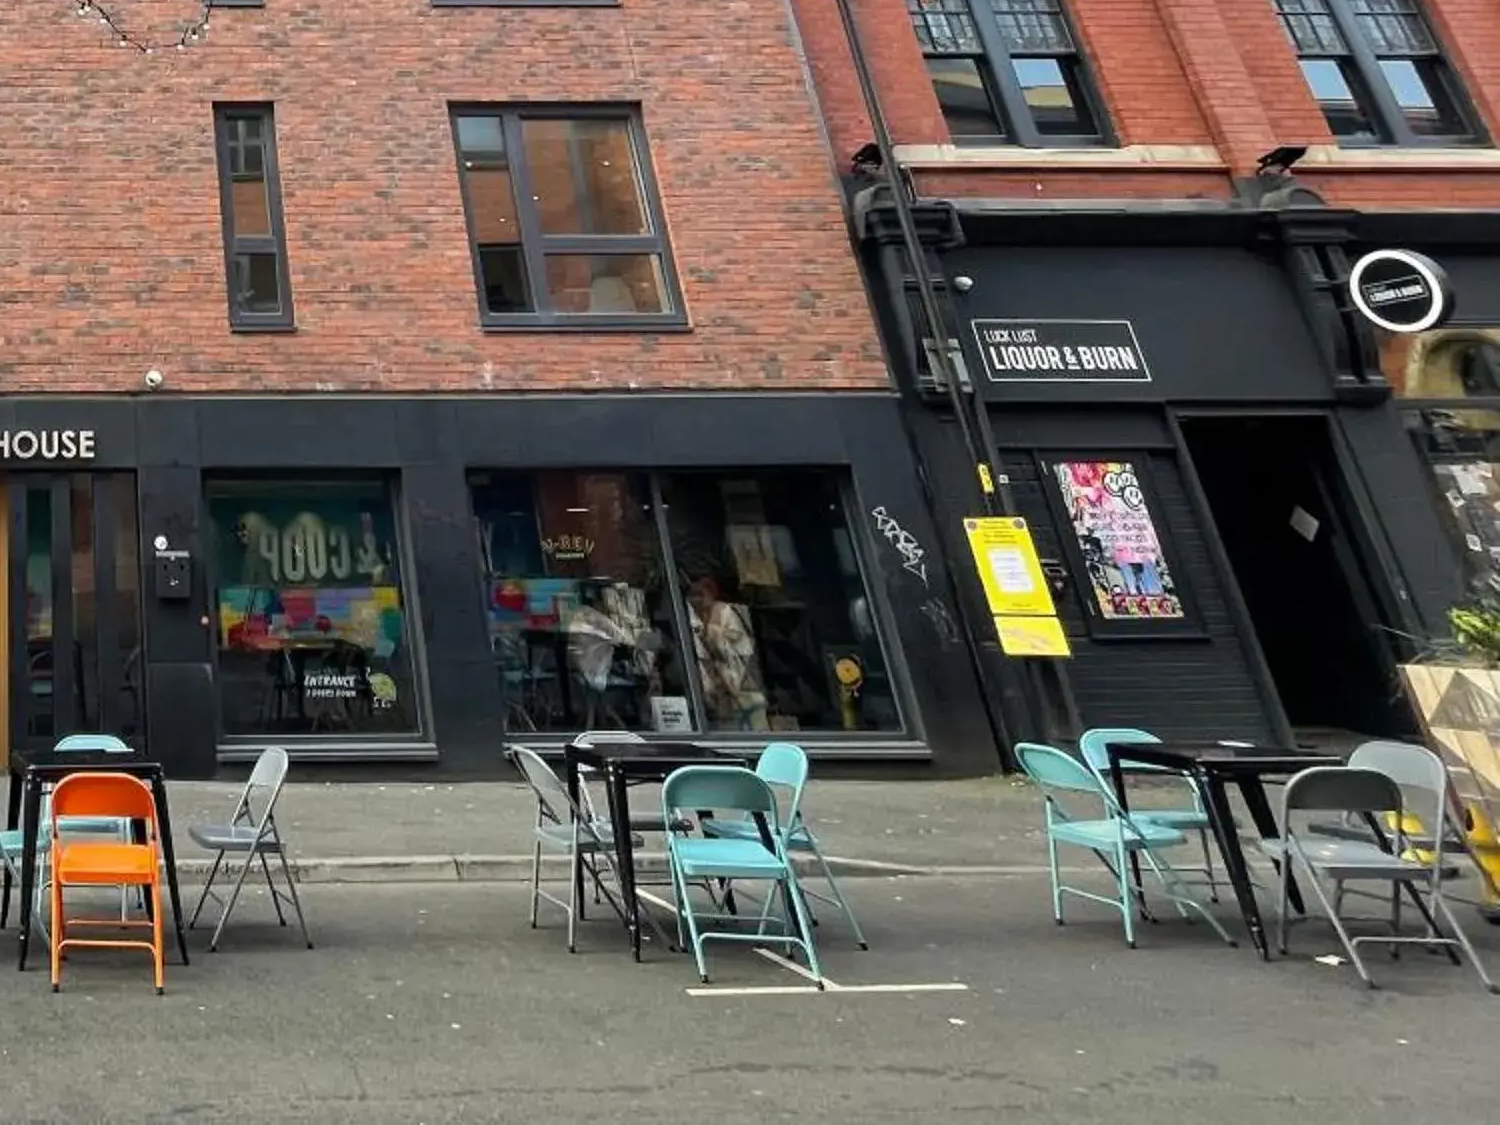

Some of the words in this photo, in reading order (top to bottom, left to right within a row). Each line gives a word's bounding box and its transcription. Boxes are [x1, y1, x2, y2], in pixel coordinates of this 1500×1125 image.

[984, 329, 1011, 343] LUCK
[1012, 329, 1038, 343] LUST
[989, 346, 1065, 371] LIQUOR
[1063, 346, 1081, 370] &
[1077, 346, 1139, 370] BURN
[304, 674, 356, 687] ENTRANCE
